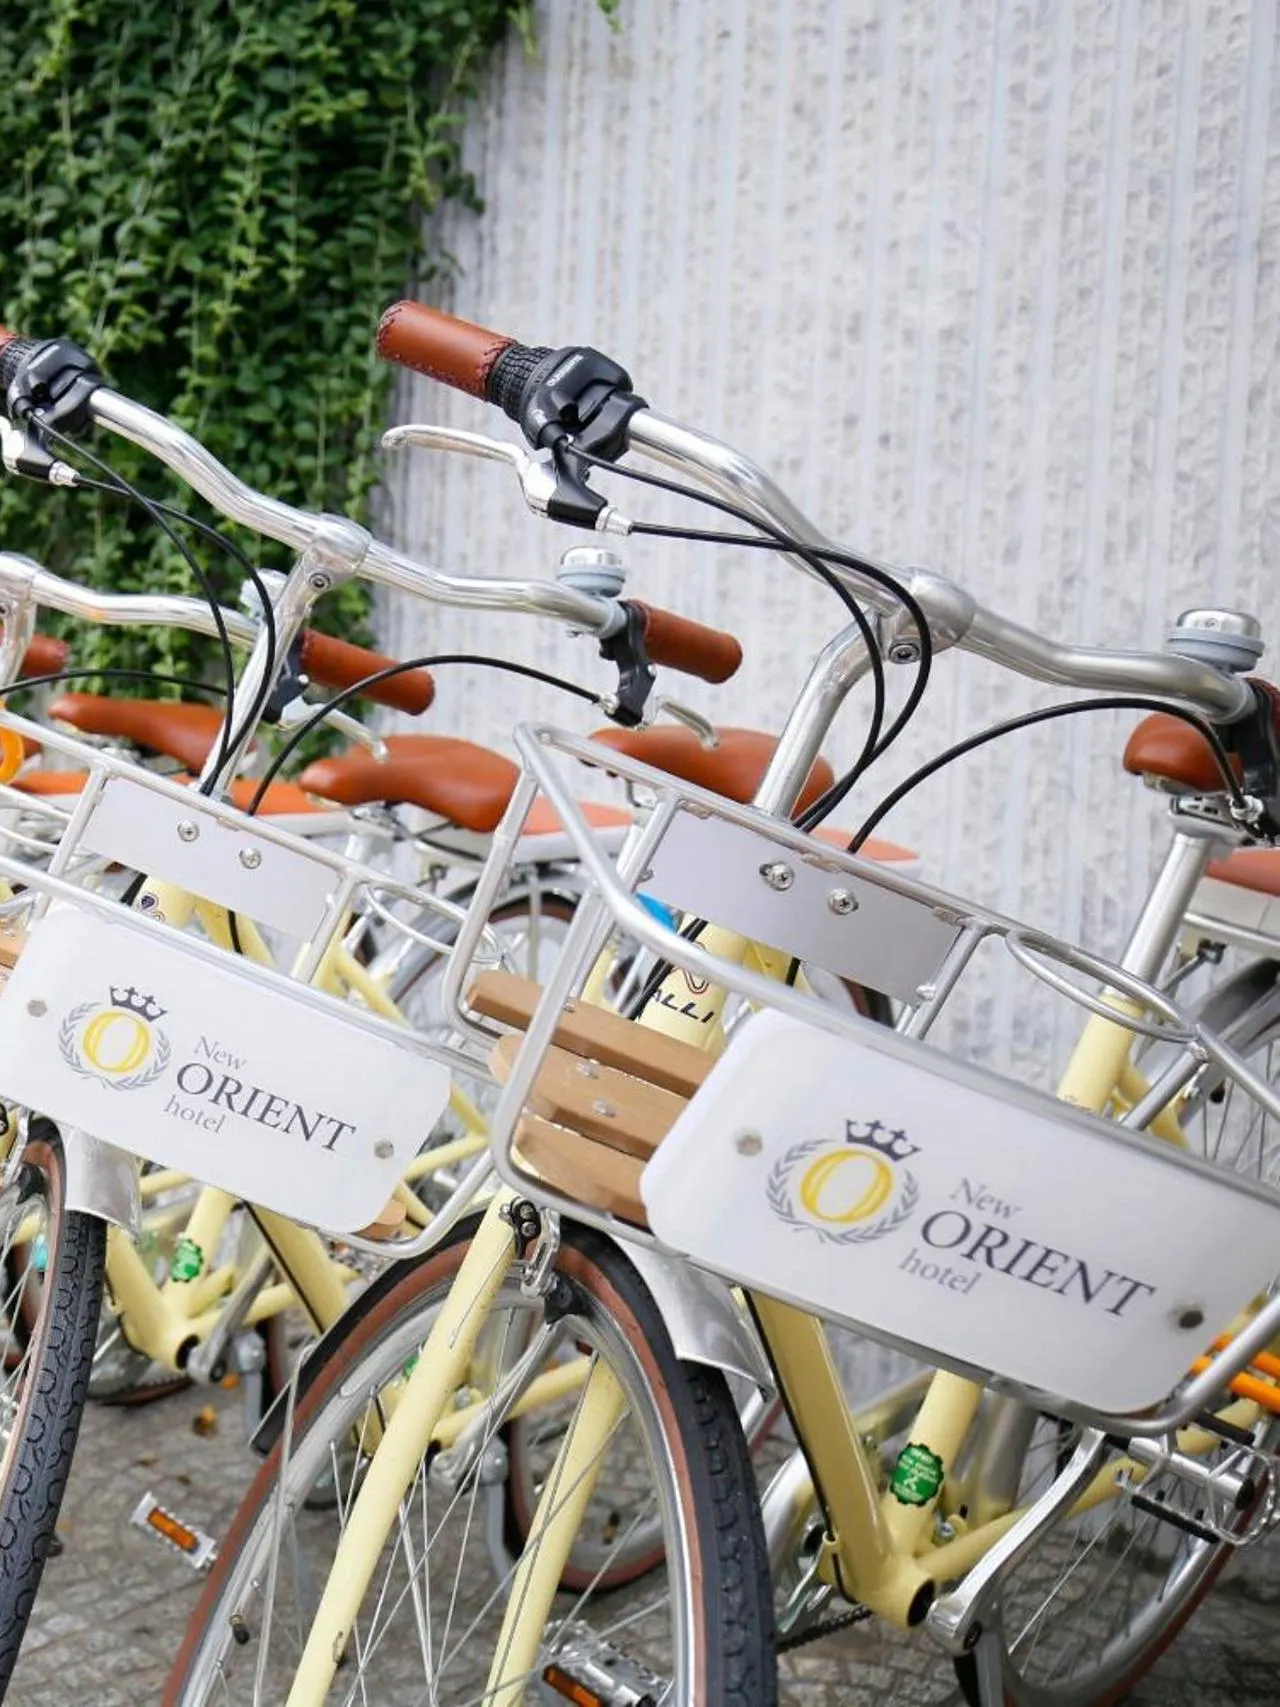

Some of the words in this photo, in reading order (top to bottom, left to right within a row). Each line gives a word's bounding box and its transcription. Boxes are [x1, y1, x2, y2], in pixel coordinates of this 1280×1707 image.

[193, 1034, 248, 1071] New
[163, 1094, 228, 1134] hotel
[176, 1062, 356, 1152] ORIENT
[799, 1148, 894, 1224] O
[948, 1177, 1023, 1221] New
[896, 1248, 983, 1297] hotel
[922, 1210, 1156, 1317] ORIENT
